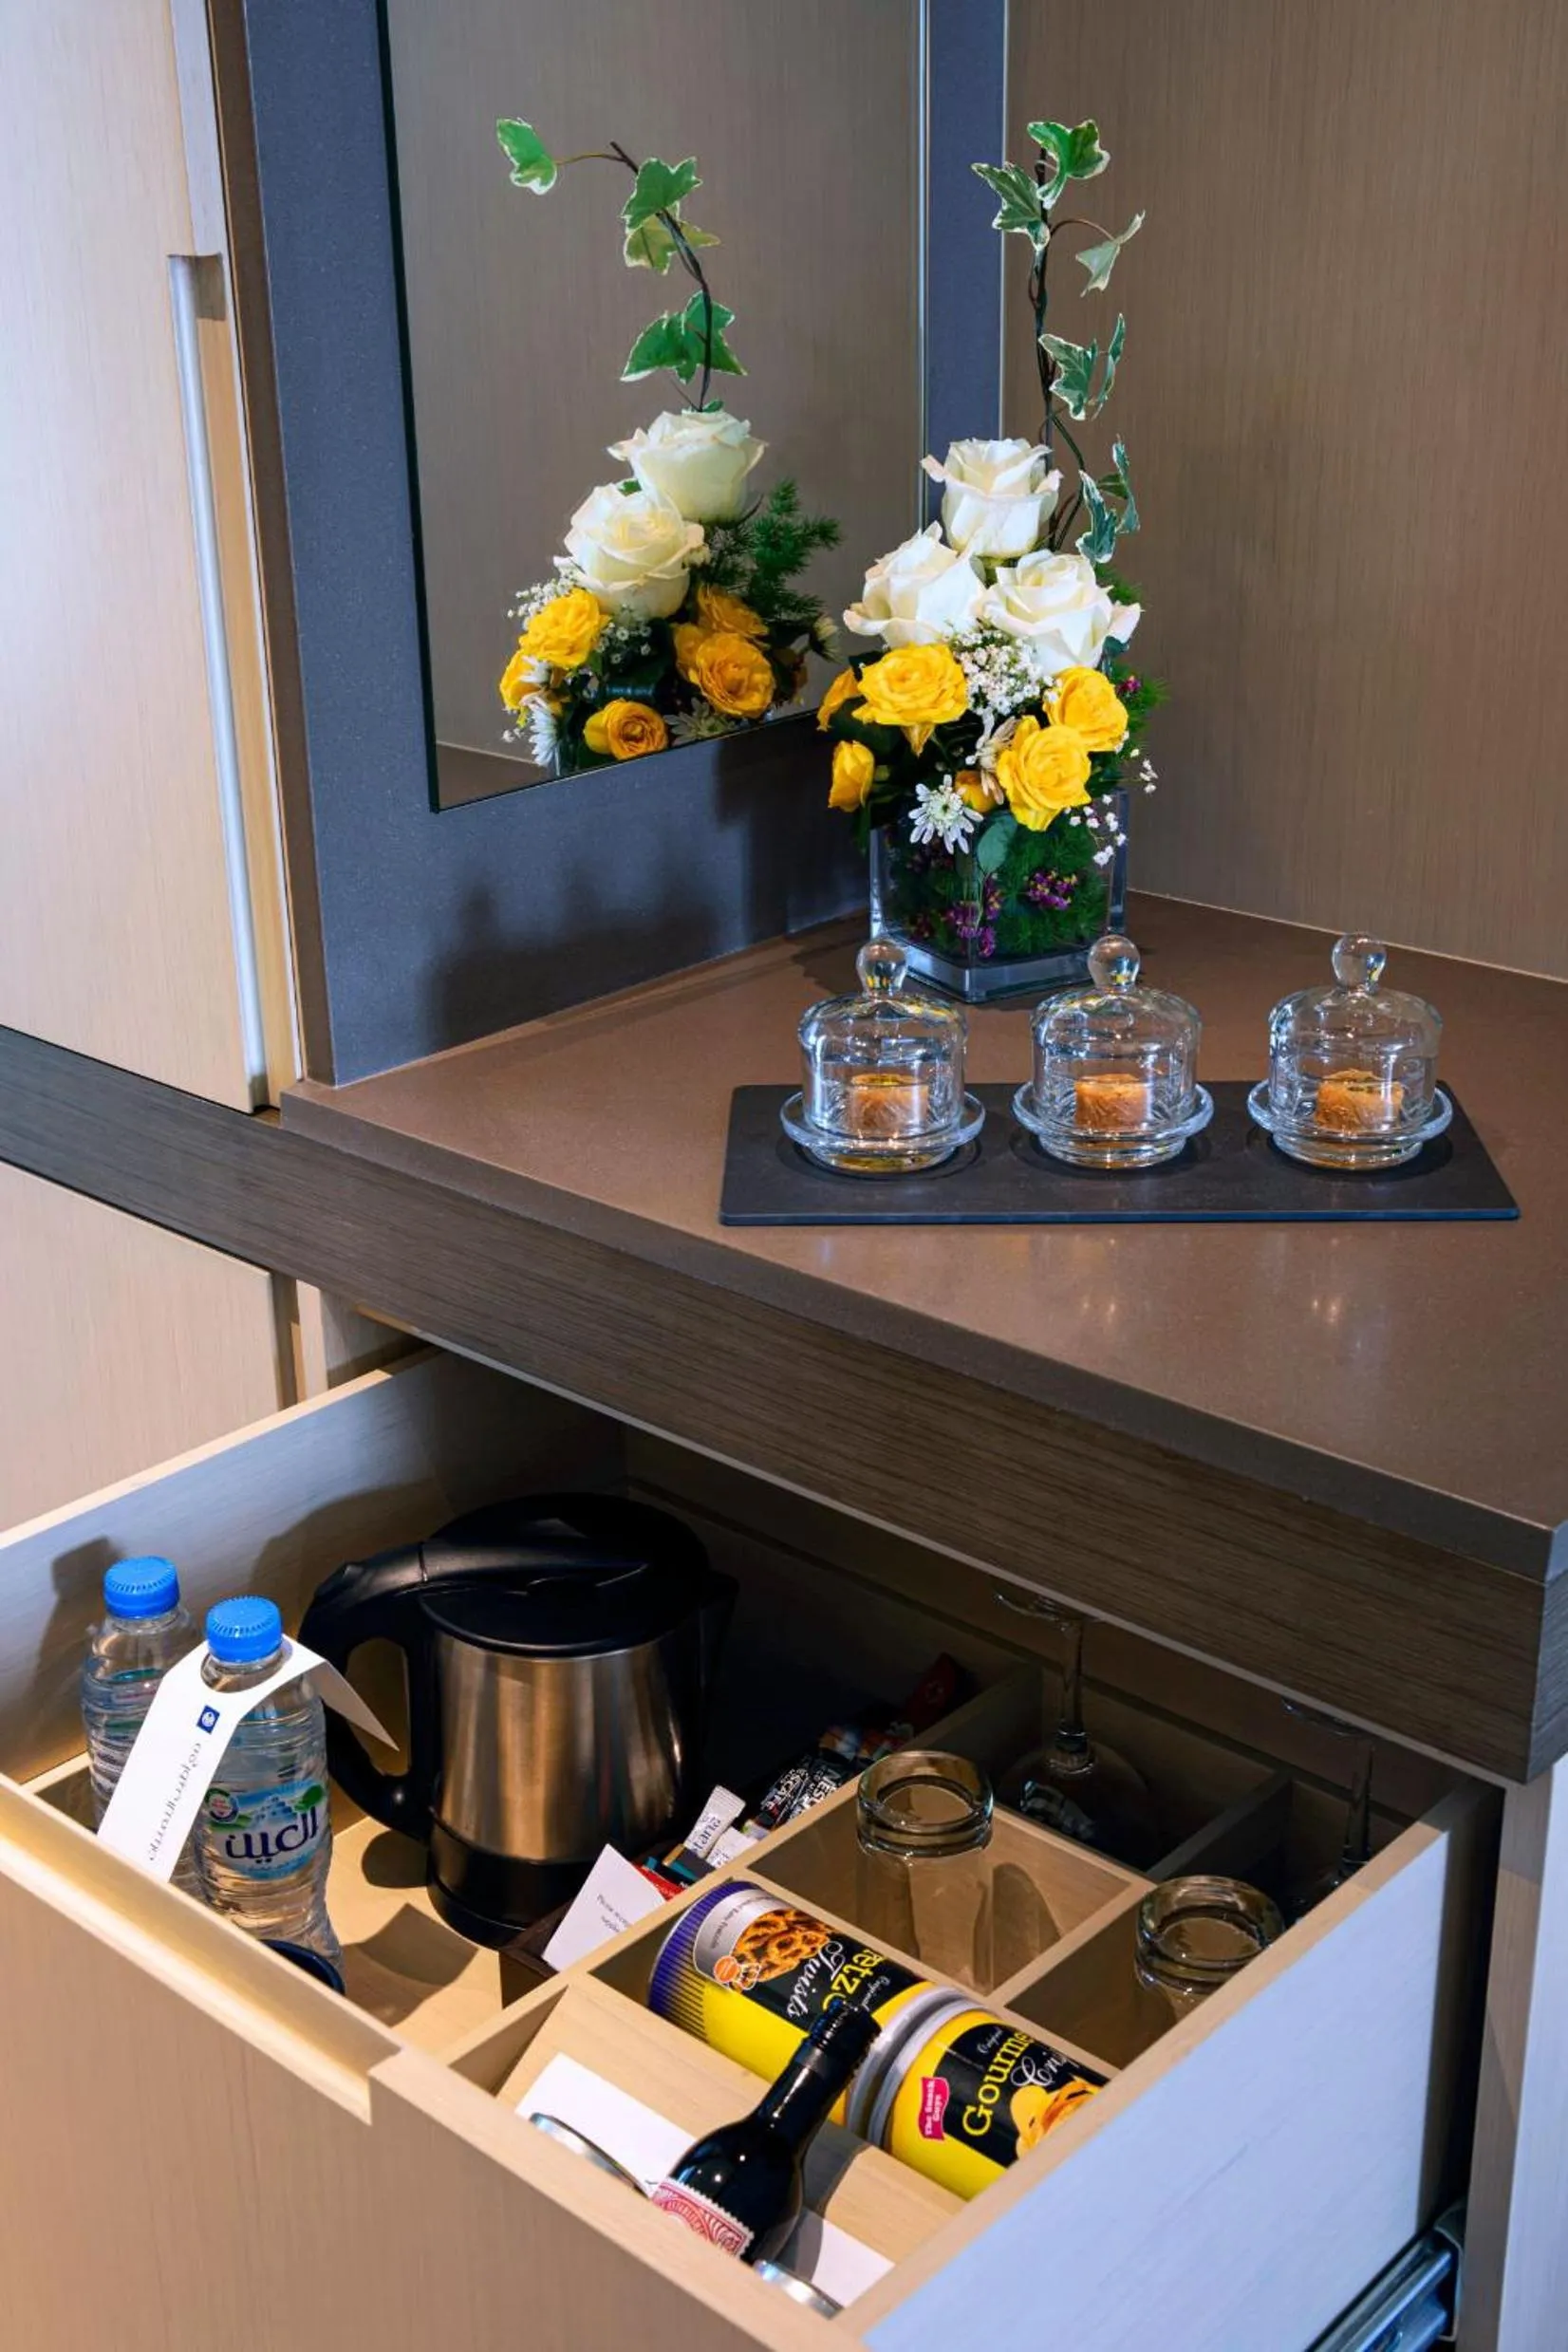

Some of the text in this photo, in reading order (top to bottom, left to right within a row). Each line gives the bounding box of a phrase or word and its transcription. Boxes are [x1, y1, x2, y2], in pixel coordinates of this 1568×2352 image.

[225, 1805, 319, 1864] العين
[786, 1940, 844, 2018] Twists
[961, 2031, 1034, 2136] Gourme
